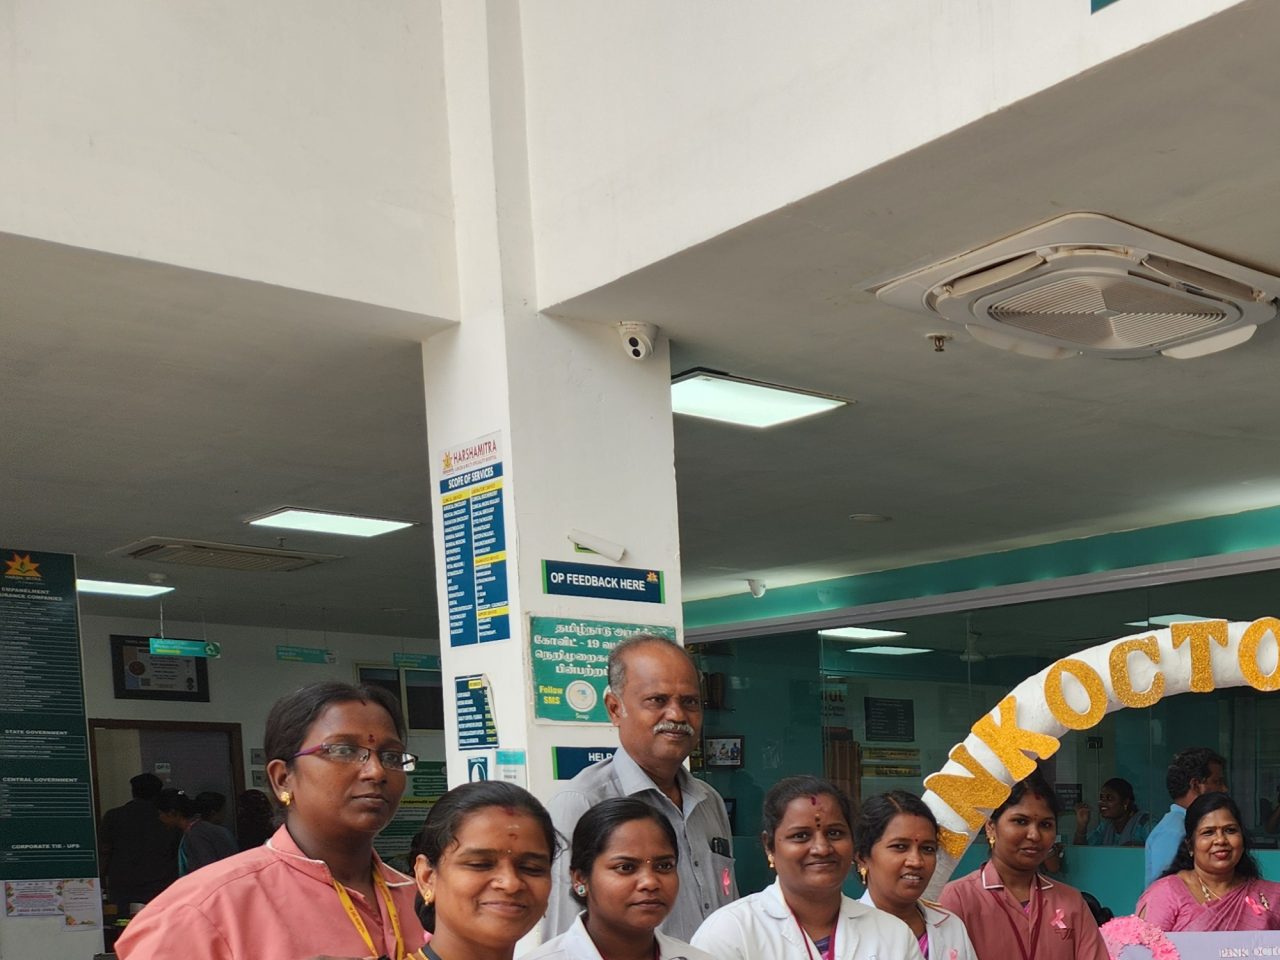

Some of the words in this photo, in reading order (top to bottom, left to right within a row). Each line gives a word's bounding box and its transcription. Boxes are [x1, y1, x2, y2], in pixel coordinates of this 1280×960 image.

[453, 439, 498, 464] HARSHAMITRA
[448, 475, 464, 489] SCOPE
[463, 474, 472, 484] OF
[471, 466, 494, 481] SERVICES
[550, 571, 565, 583] OP
[566, 573, 619, 589] FEEDBACK
[620, 578, 646, 591] HERE
[586, 638, 600, 648] 19
[539, 685, 563, 695] Follow
[543, 696, 561, 705] SMS
[1219, 947, 1249, 958] PINK
